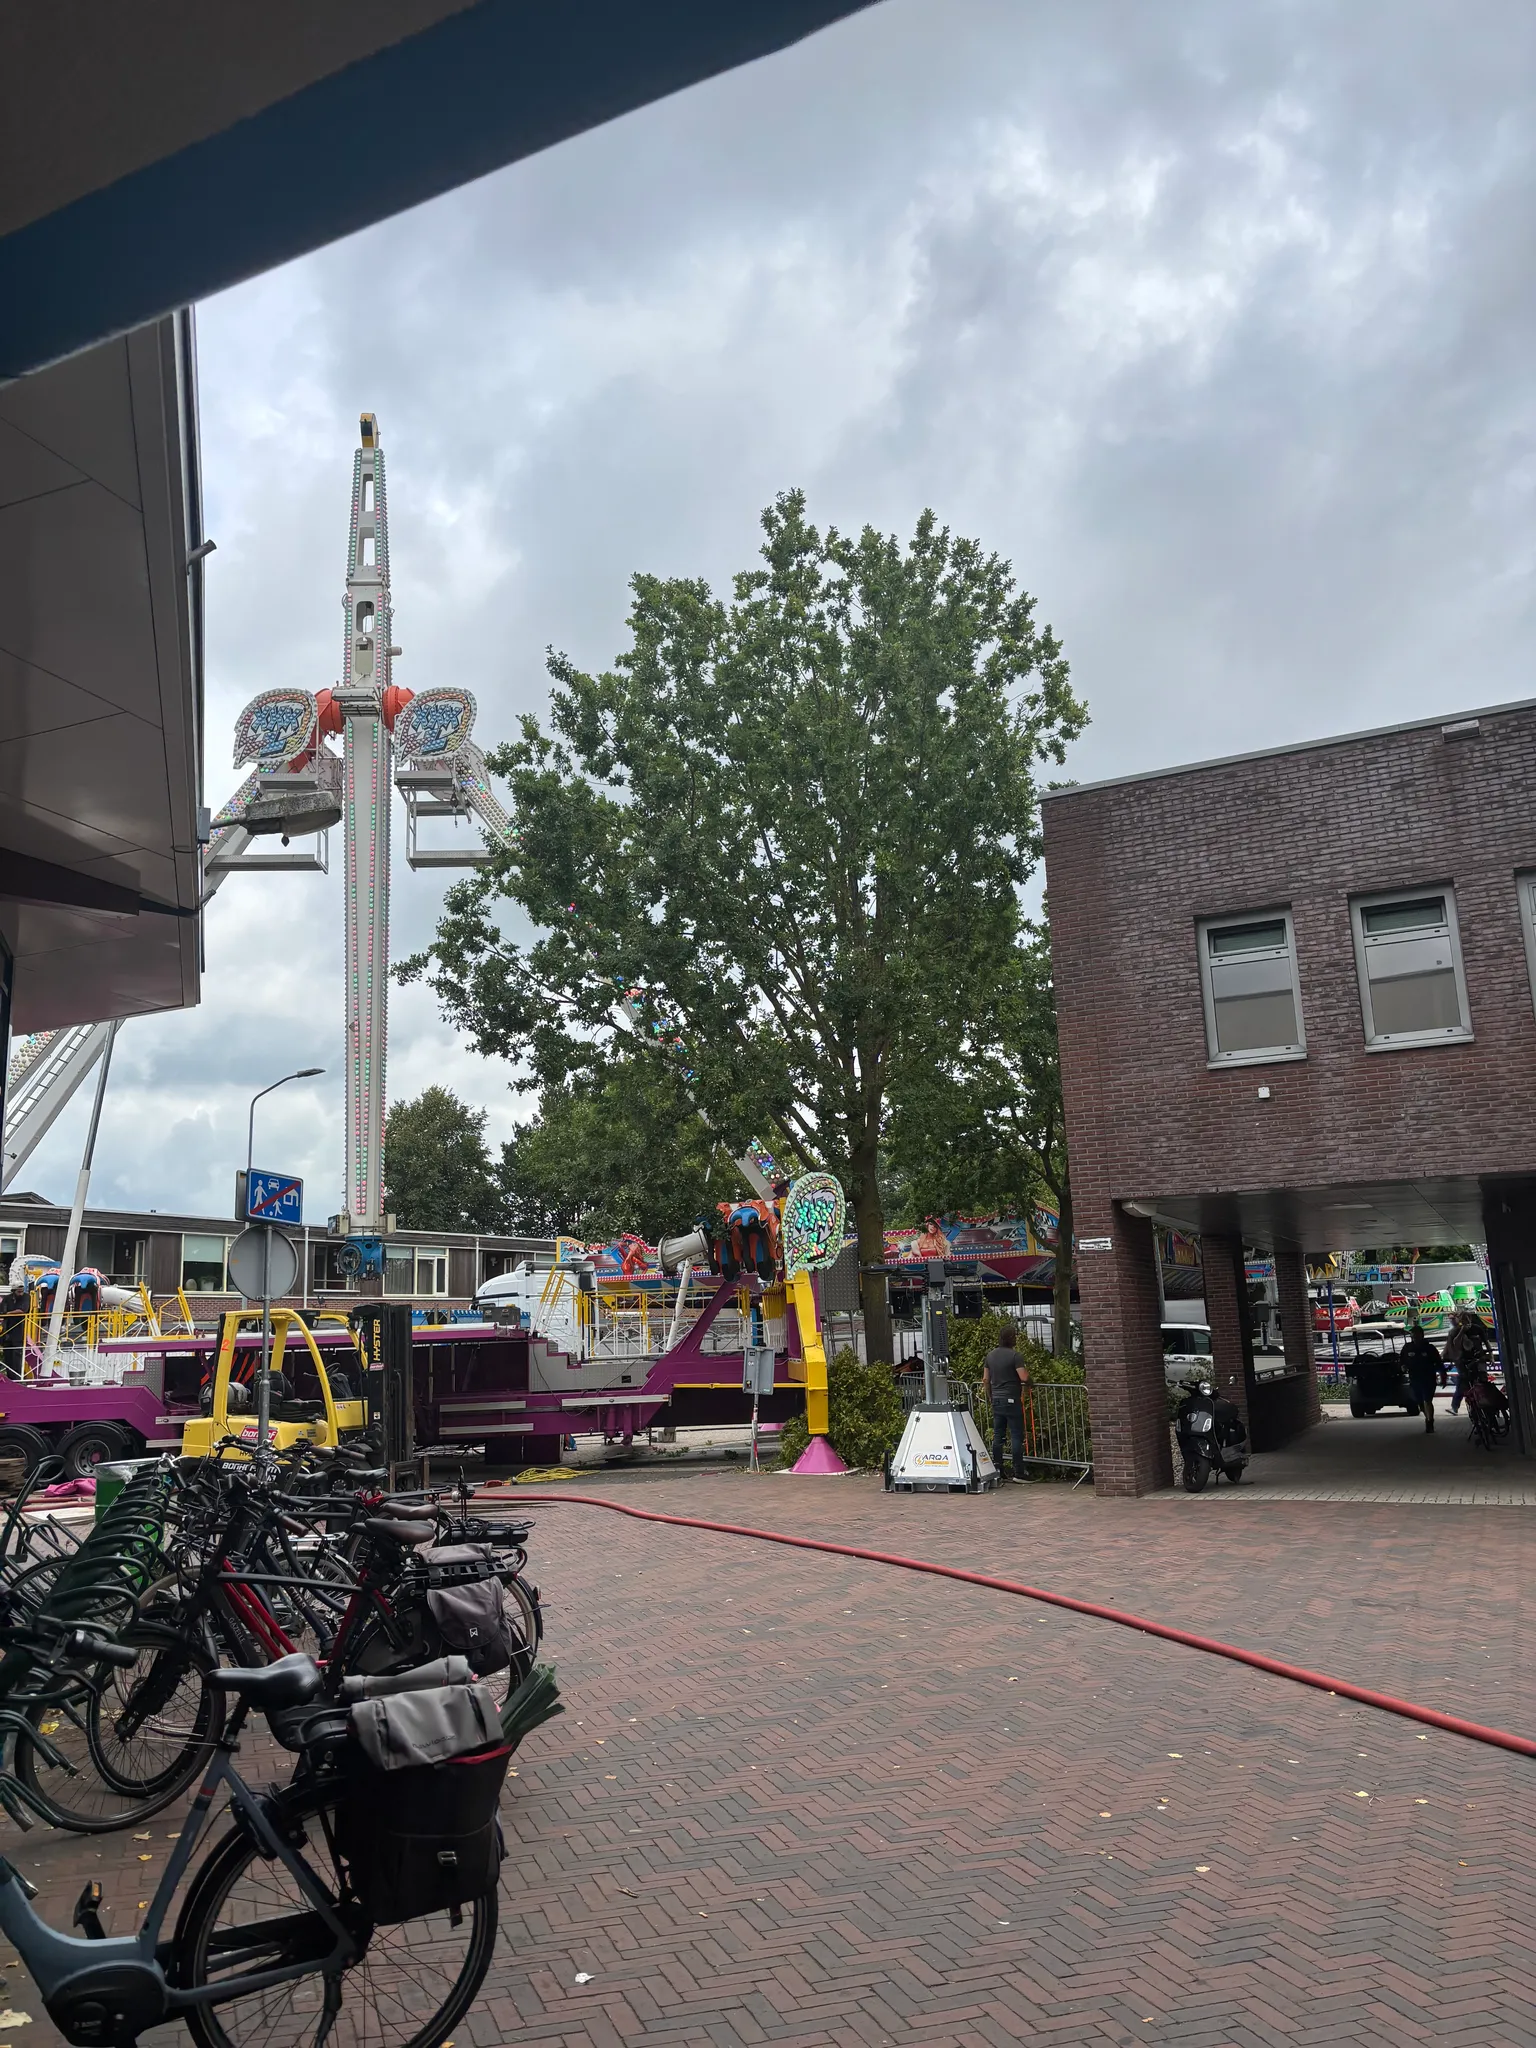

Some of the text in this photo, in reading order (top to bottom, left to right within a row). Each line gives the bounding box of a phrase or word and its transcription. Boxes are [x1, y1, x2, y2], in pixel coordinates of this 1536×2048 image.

[221, 1338, 231, 1352] 2
[373, 1318, 381, 1362] HYSTER
[241, 1429, 277, 1439] bonf
[228, 1617, 246, 1643] GAZELLE
